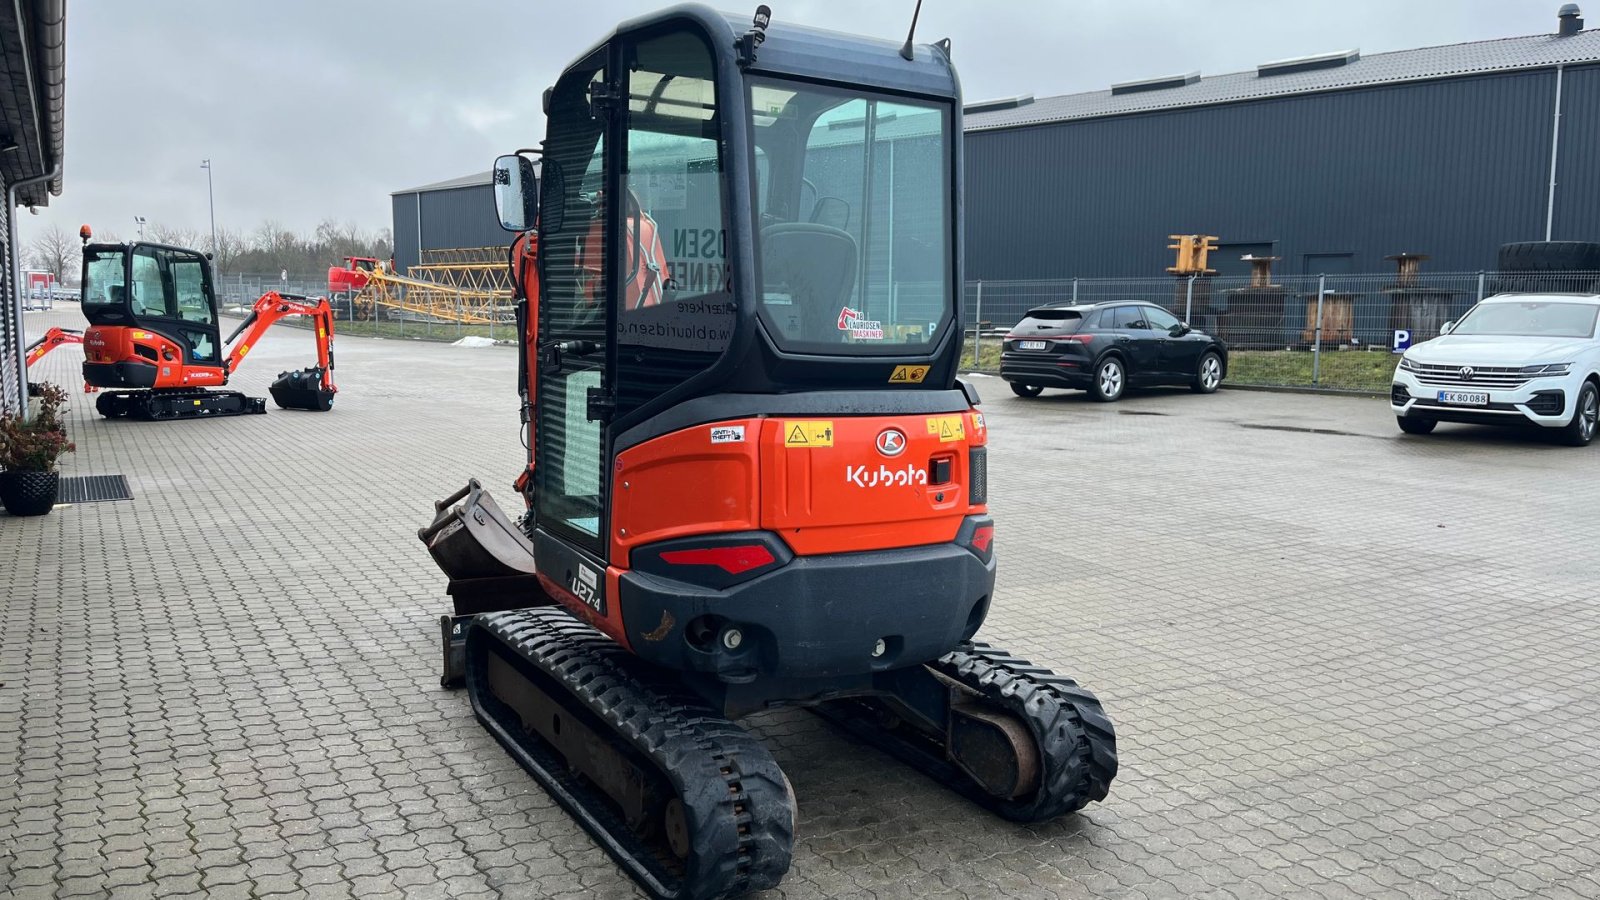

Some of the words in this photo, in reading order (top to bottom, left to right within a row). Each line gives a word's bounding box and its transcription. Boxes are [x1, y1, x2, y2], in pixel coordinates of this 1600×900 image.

[849, 321, 880, 329] LAURIDSEN
[853, 329, 882, 338] MASKINER
[1394, 330, 1410, 348] P
[1444, 393, 1455, 401] EK
[1457, 394, 1468, 402] 80
[1470, 394, 1486, 403] 088
[846, 463, 927, 488] Kubota
[572, 577, 601, 611] U27-4
